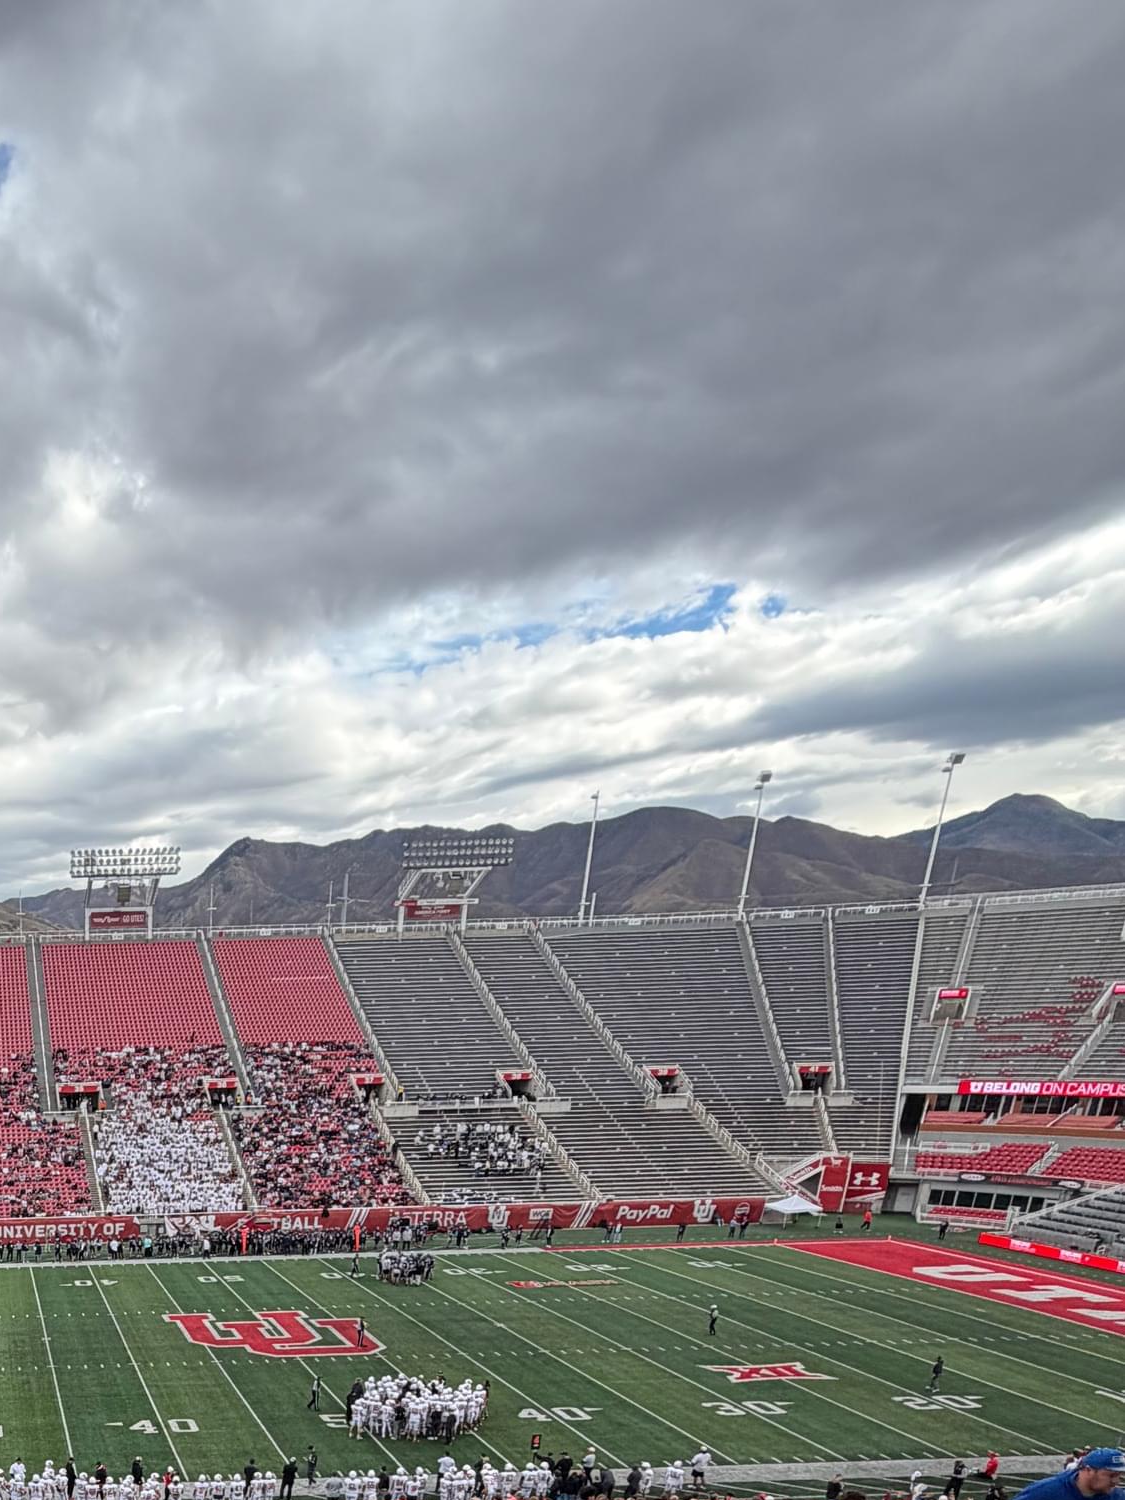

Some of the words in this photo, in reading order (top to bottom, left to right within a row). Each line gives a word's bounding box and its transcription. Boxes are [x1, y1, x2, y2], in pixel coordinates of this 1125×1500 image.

[982, 1081, 1041, 1093] BELONG
[1042, 1082, 1062, 1094] ON
[615, 1204, 674, 1223] PayPal
[102, 1222, 125, 1236] OF
[196, 1275, 247, 1283] 50
[701, 1401, 788, 1416] 30
[891, 1395, 981, 1410] 20
[319, 1413, 350, 1428] 5
[517, 1406, 593, 1421] 40
[128, 1418, 201, 1434] 40
